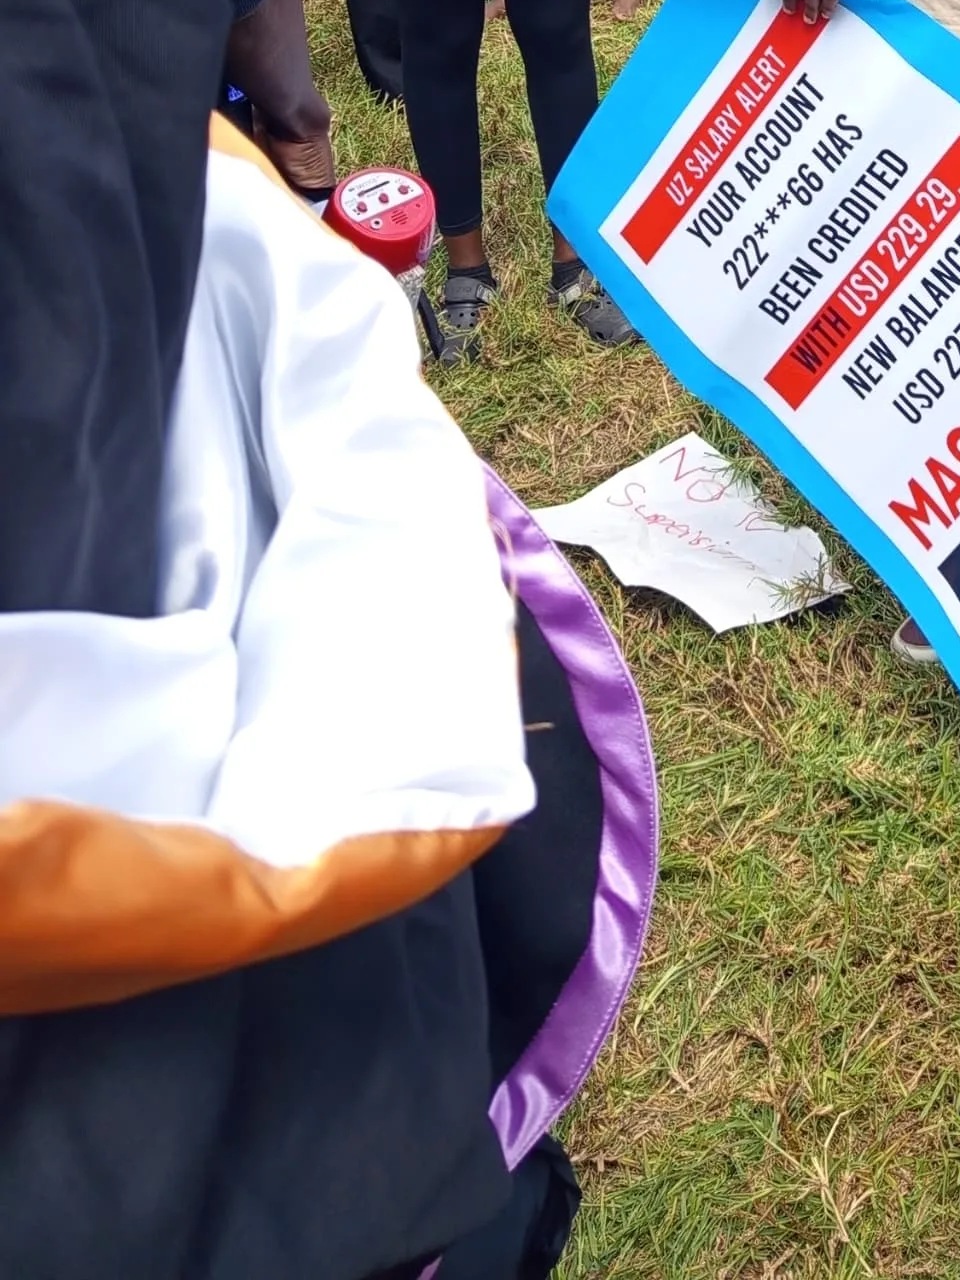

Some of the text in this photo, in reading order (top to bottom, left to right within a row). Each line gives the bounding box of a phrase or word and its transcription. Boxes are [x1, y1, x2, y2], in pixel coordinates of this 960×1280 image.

[665, 45, 786, 207] UZ SALARY ALERT
[686, 72, 824, 248] YOUR ACCOUNT
[811, 113, 863, 174] HAS
[758, 148, 909, 326] BEEN CREDITED
[790, 305, 852, 375] WITH
[837, 259, 890, 318] USD
[841, 334, 898, 400] NEW
[892, 368, 946, 424] USD
